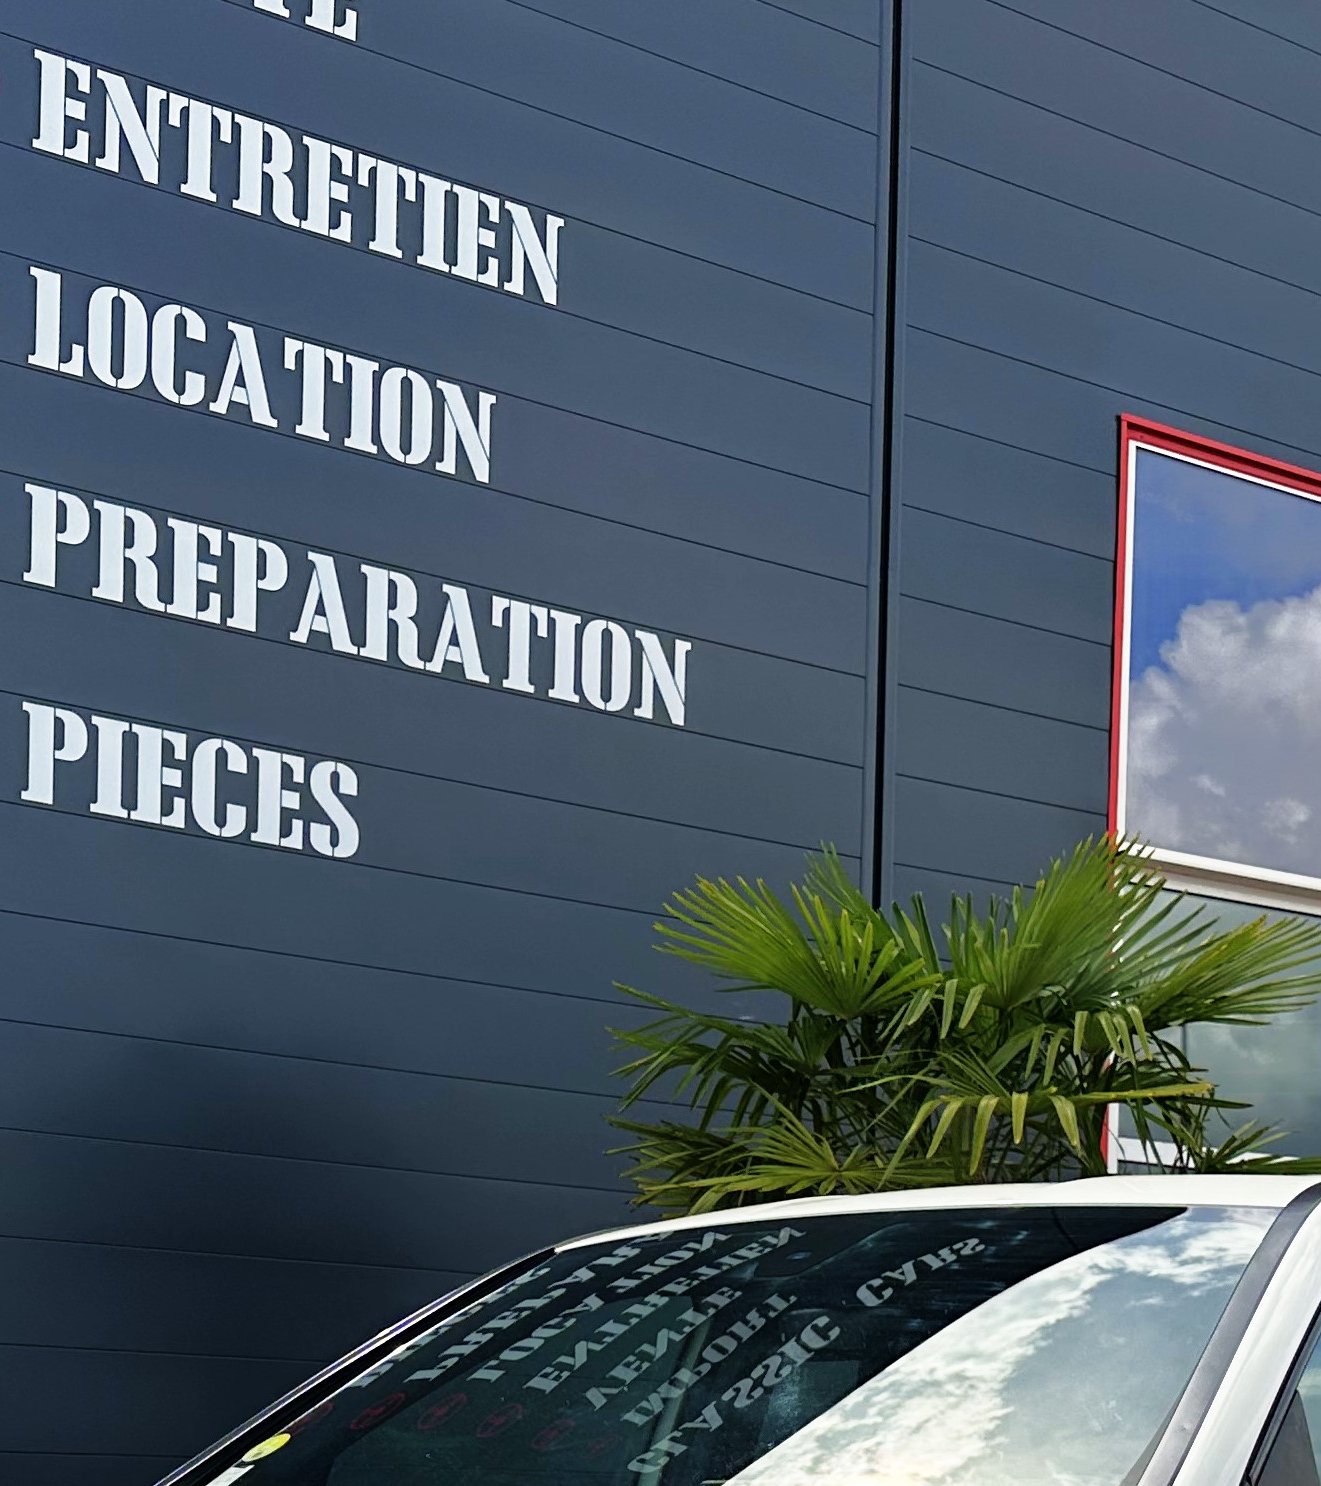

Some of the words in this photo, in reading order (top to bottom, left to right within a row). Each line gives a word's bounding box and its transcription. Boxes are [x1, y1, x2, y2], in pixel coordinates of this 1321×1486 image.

[33, 49, 563, 305] ENTRETIEN
[27, 264, 496, 484] LOCATION
[23, 482, 692, 727] PREPARATION
[20, 701, 361, 859] PIECES
